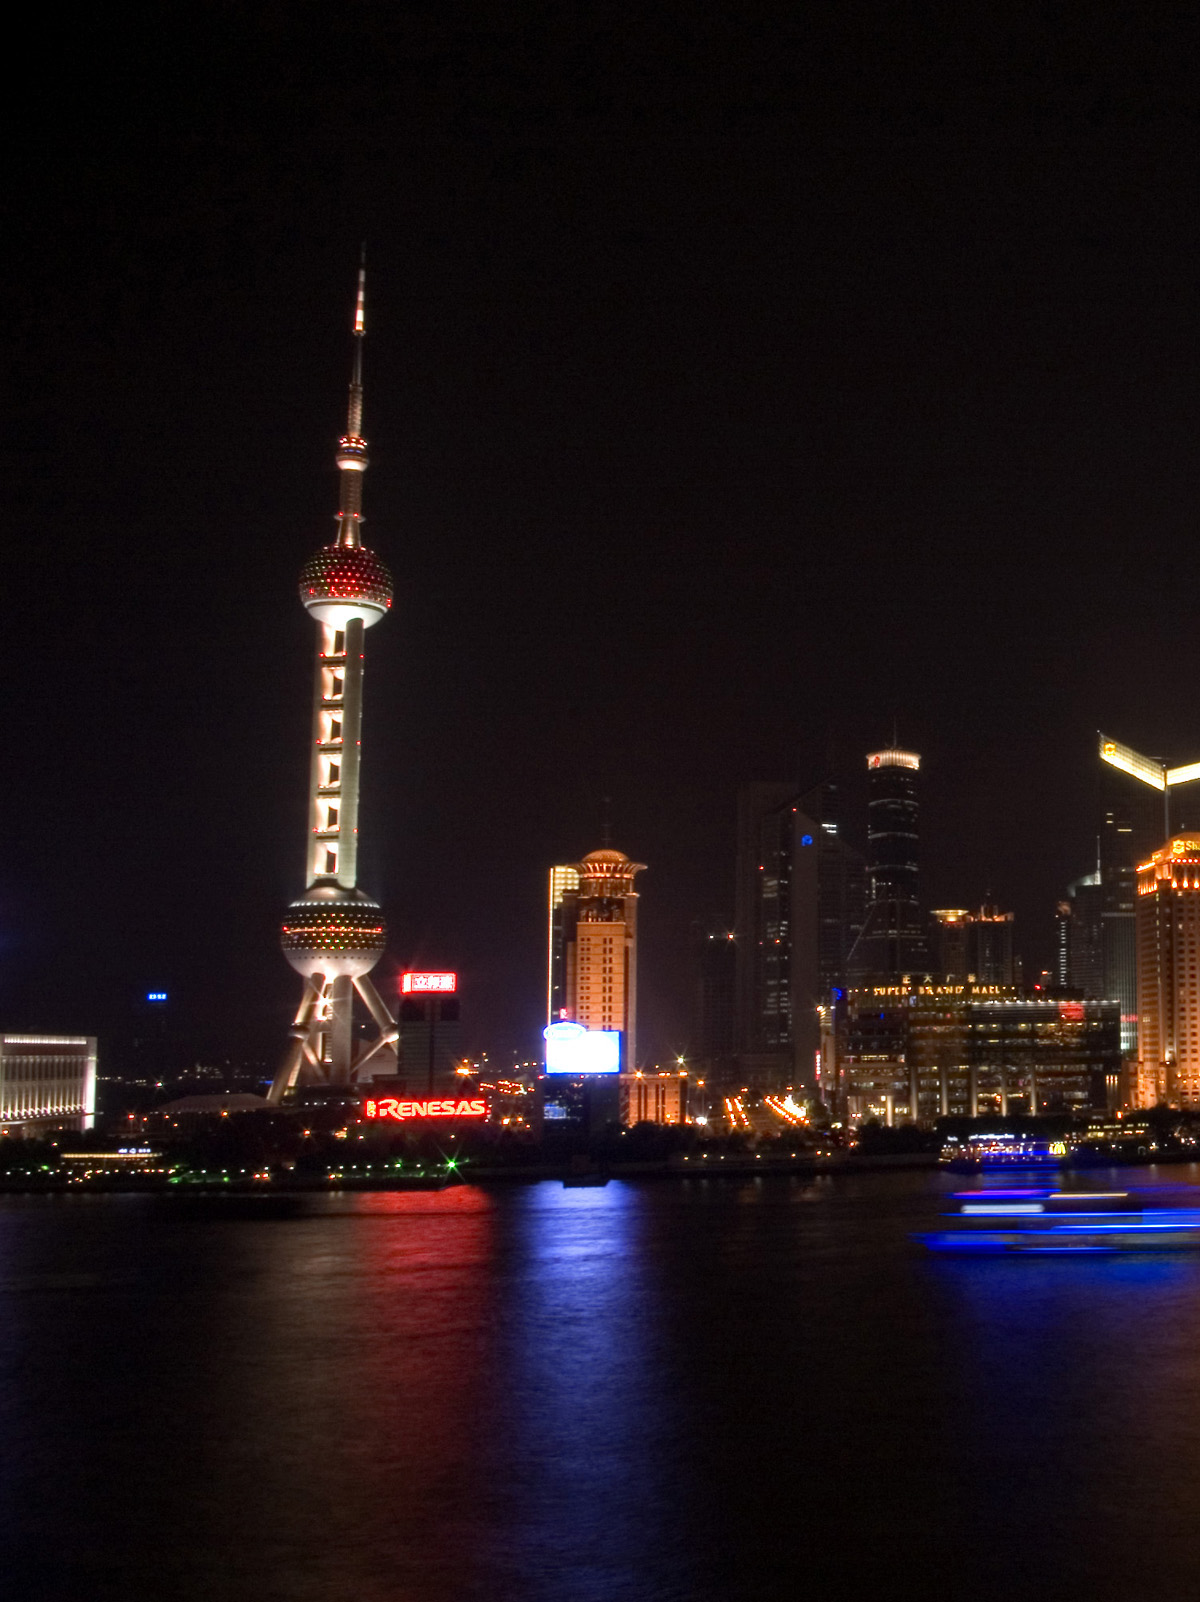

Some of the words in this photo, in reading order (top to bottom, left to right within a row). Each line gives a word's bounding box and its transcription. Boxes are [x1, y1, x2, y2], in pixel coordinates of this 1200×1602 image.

[873, 986, 909, 996] SUPER
[918, 985, 964, 995] BRAND
[971, 985, 1001, 995] MALL
[378, 1099, 486, 1120] RENESAS
